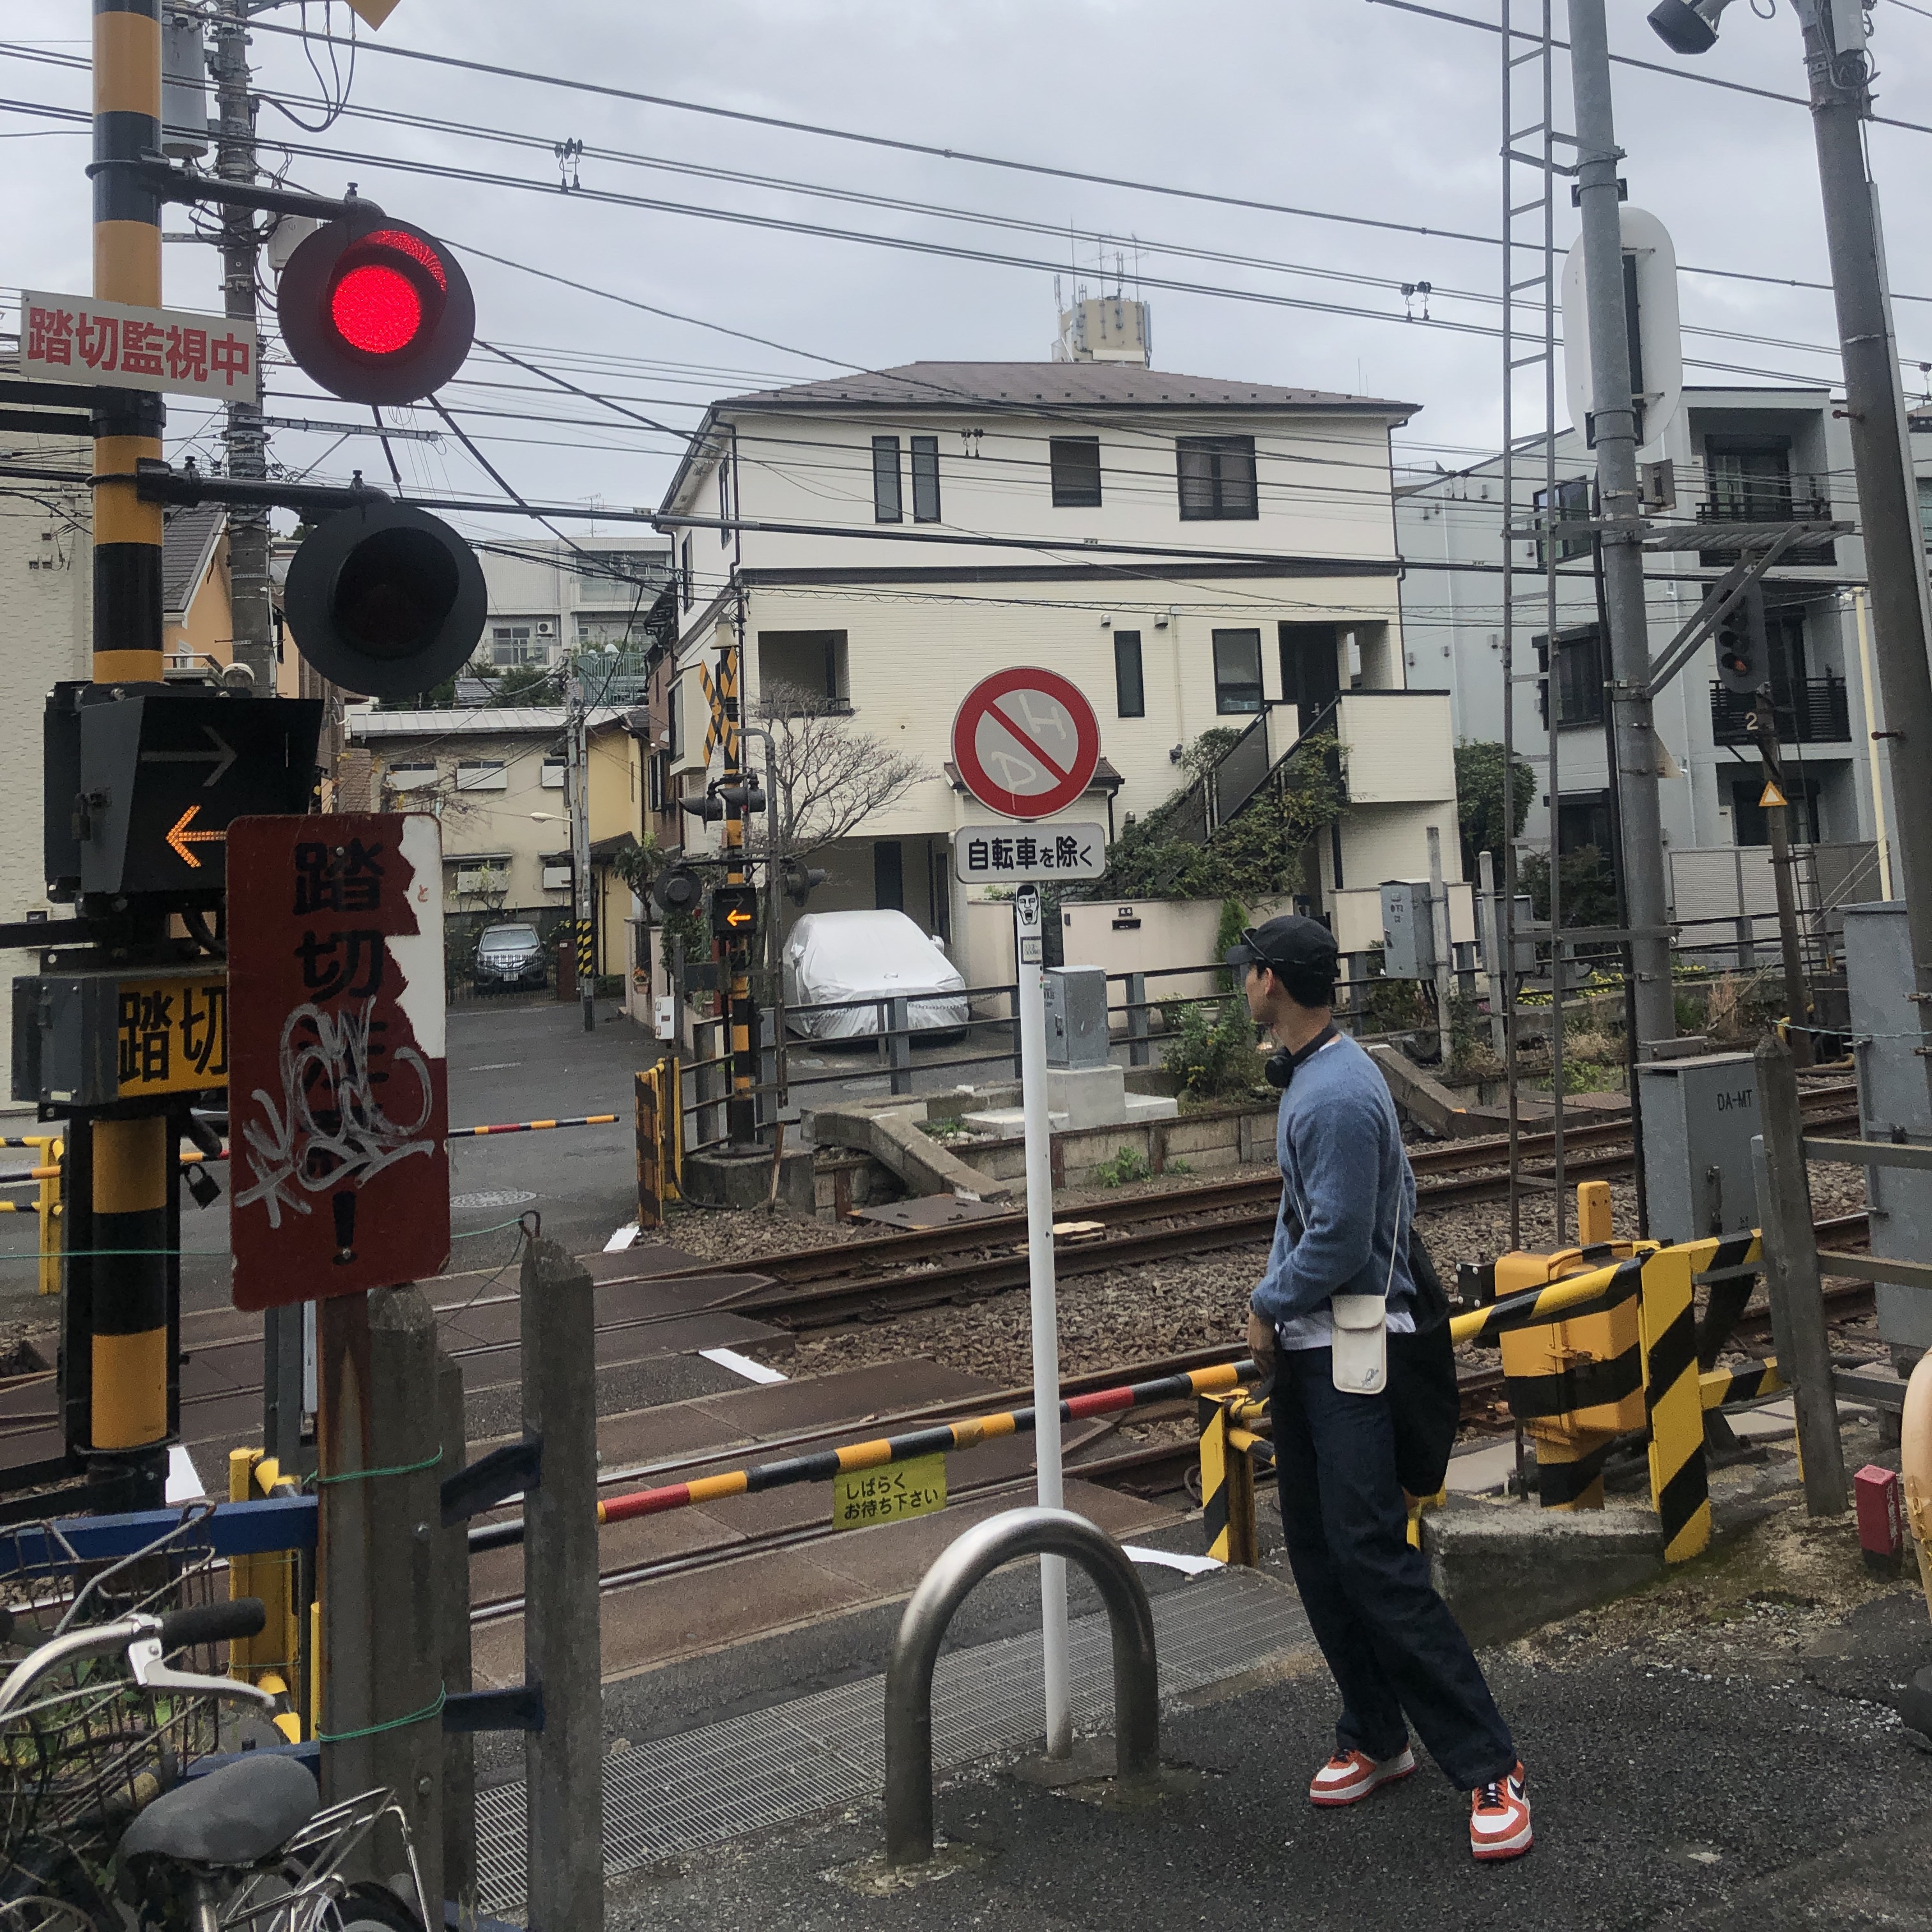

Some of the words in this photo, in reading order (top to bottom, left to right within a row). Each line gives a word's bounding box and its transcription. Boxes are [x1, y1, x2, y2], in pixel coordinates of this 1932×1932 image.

[27, 307, 250, 387] 踏切監視中
[1745, 712, 1759, 730] 2
[968, 835, 1093, 871] 自転車を除く
[119, 986, 228, 1084] 踏切
[1717, 1089, 1752, 1111] DA-MT
[846, 1472, 906, 1500] しばらく
[844, 1489, 939, 1520] お待ち下さい
